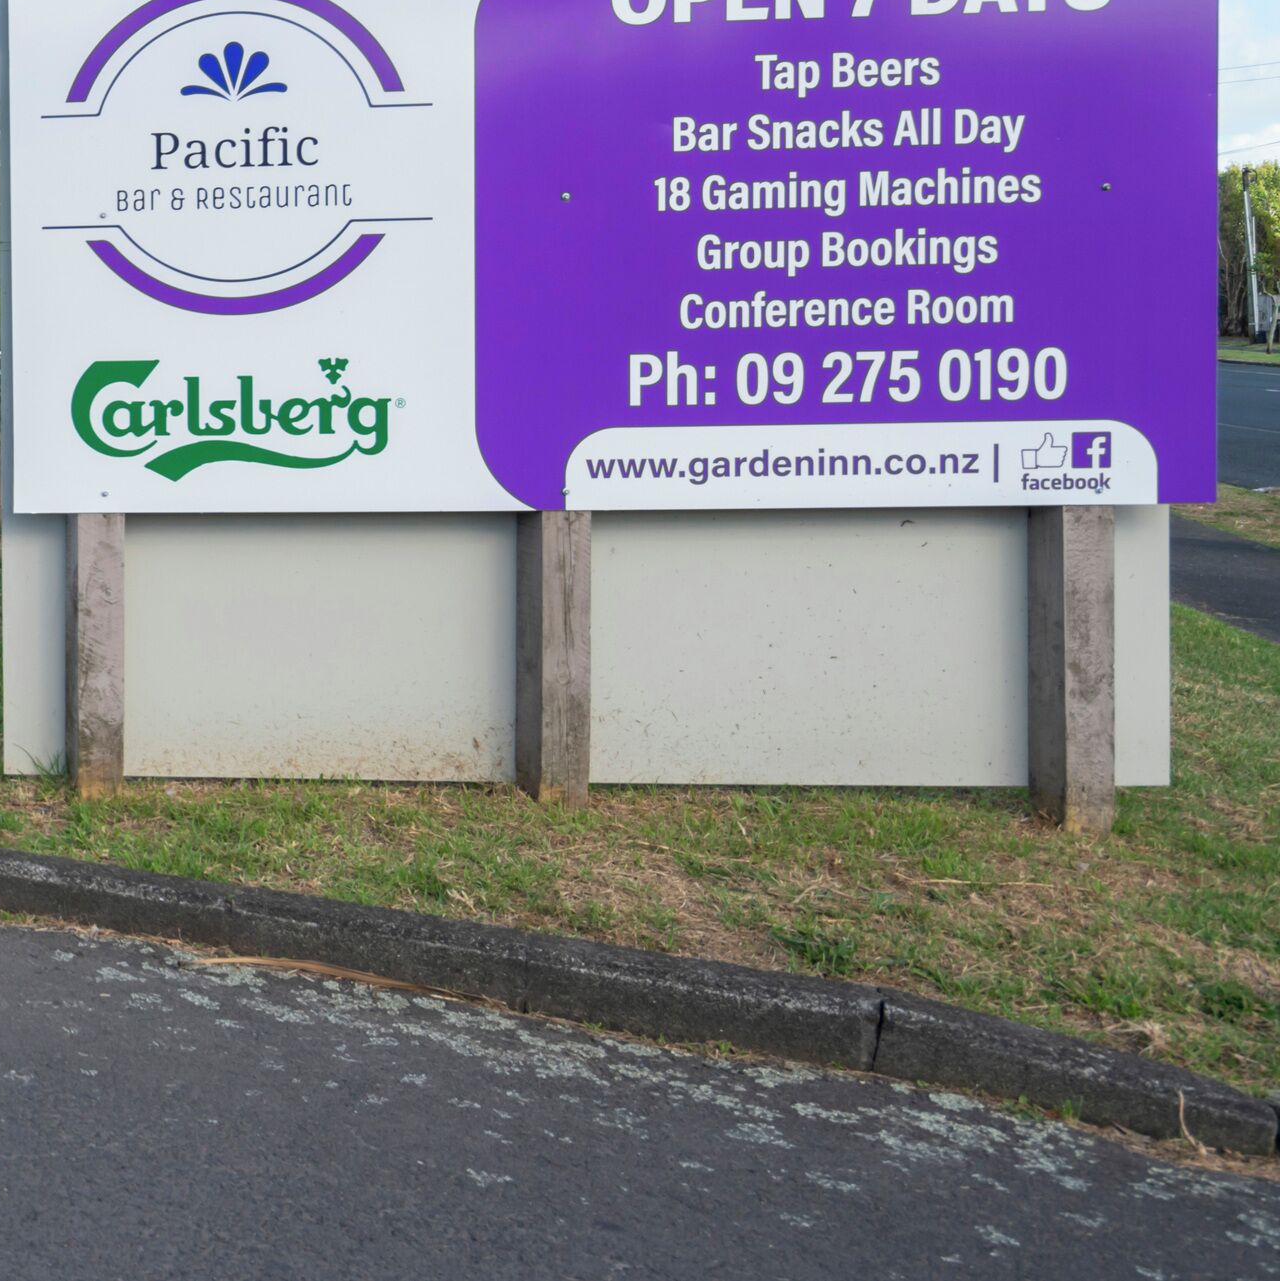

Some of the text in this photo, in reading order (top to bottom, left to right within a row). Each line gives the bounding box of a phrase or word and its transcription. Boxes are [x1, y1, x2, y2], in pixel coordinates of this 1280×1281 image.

[754, 52, 941, 98] Tap Beers
[150, 126, 320, 170] Pacific
[672, 107, 1026, 153] Bar Snacks All Day
[116, 183, 353, 212] Bar & Restaurant
[653, 167, 1042, 217] 18 Gaming Machines
[696, 227, 999, 277] Group Bookings
[679, 288, 1015, 329] Conference Room
[628, 346, 1068, 407] Ph: 09 275 0190
[71, 359, 392, 458] Carlsberg
[586, 447, 980, 487] www.gardeninn.co.nz
[1021, 472, 1111, 491] facebook
